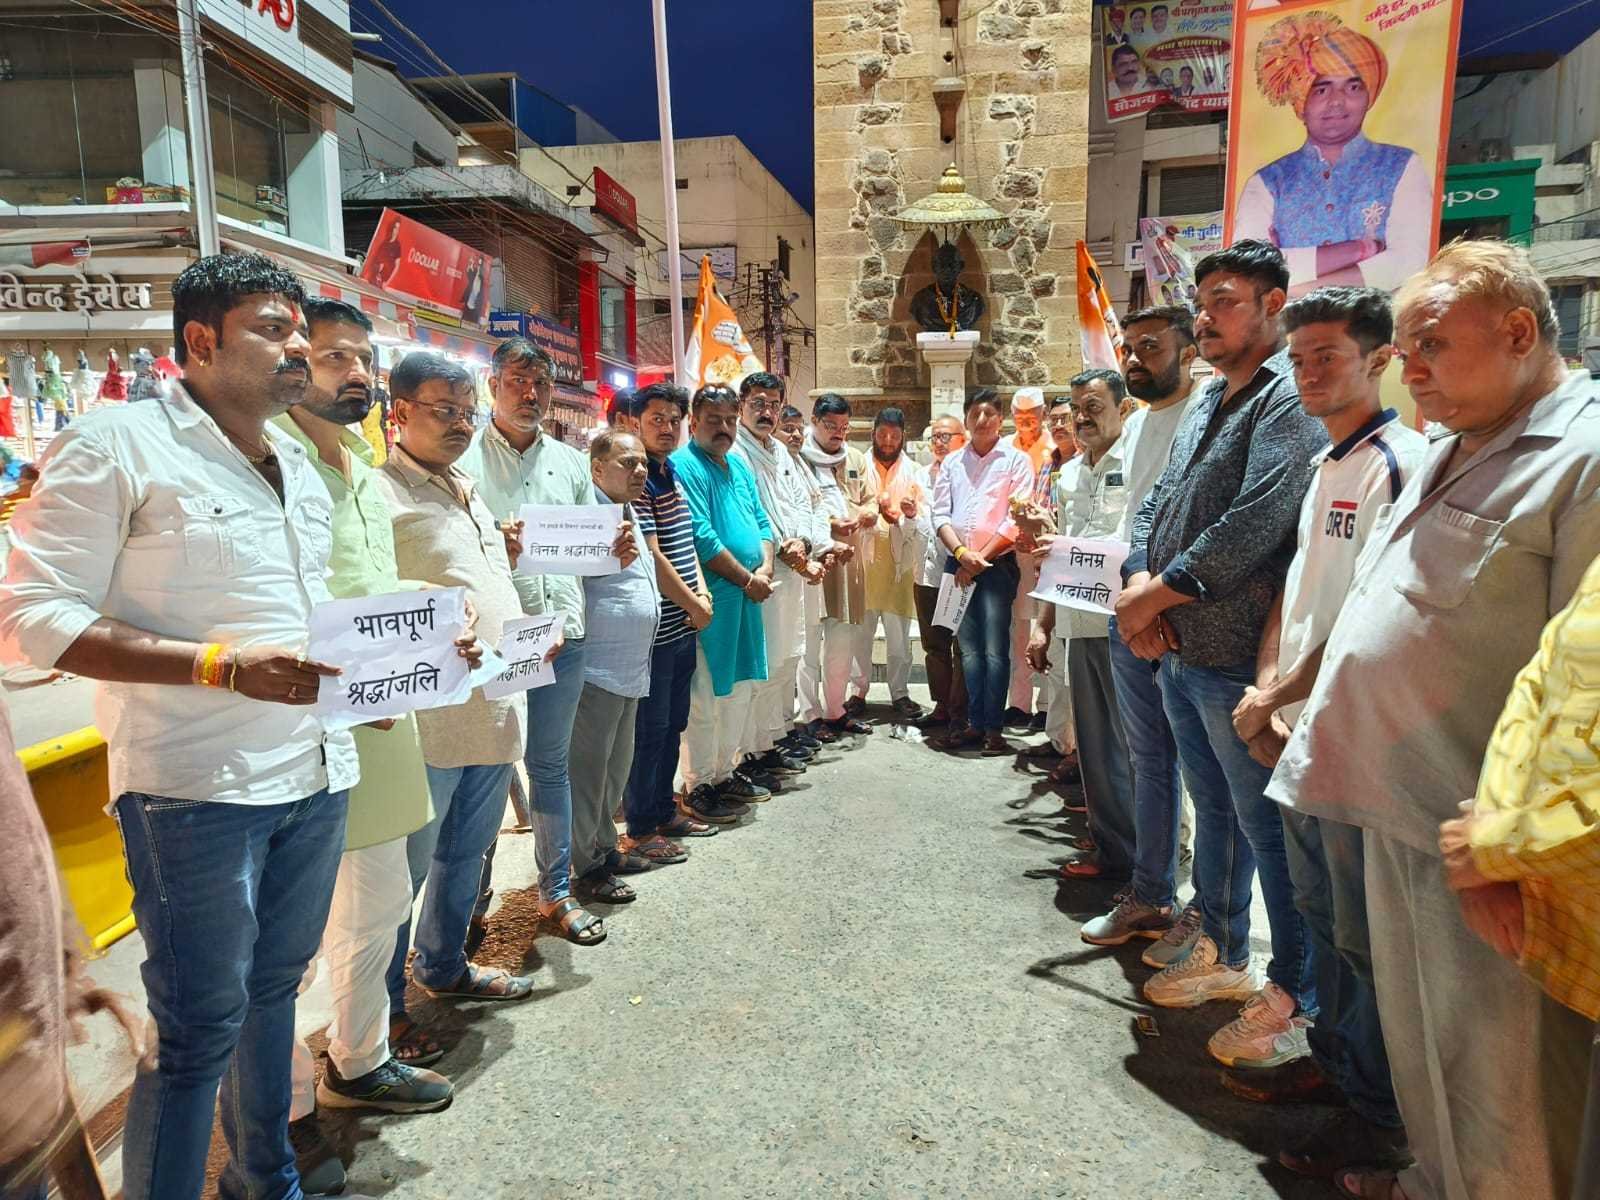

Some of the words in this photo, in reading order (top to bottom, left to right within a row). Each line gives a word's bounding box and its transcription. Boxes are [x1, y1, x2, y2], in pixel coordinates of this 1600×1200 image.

[1441, 187, 1500, 208] po
[414, 251, 440, 270] DOLLAR
[0, 272, 65, 313] विन्द
[530, 542, 560, 557] विनम्र
[563, 541, 611, 557] श्रद्धांजलि
[1070, 546, 1106, 569] विनम्र
[353, 598, 436, 642] भावपूर्ण
[516, 617, 556, 645] भावपूर्ण
[347, 661, 441, 706] श्रद्धांजलि
